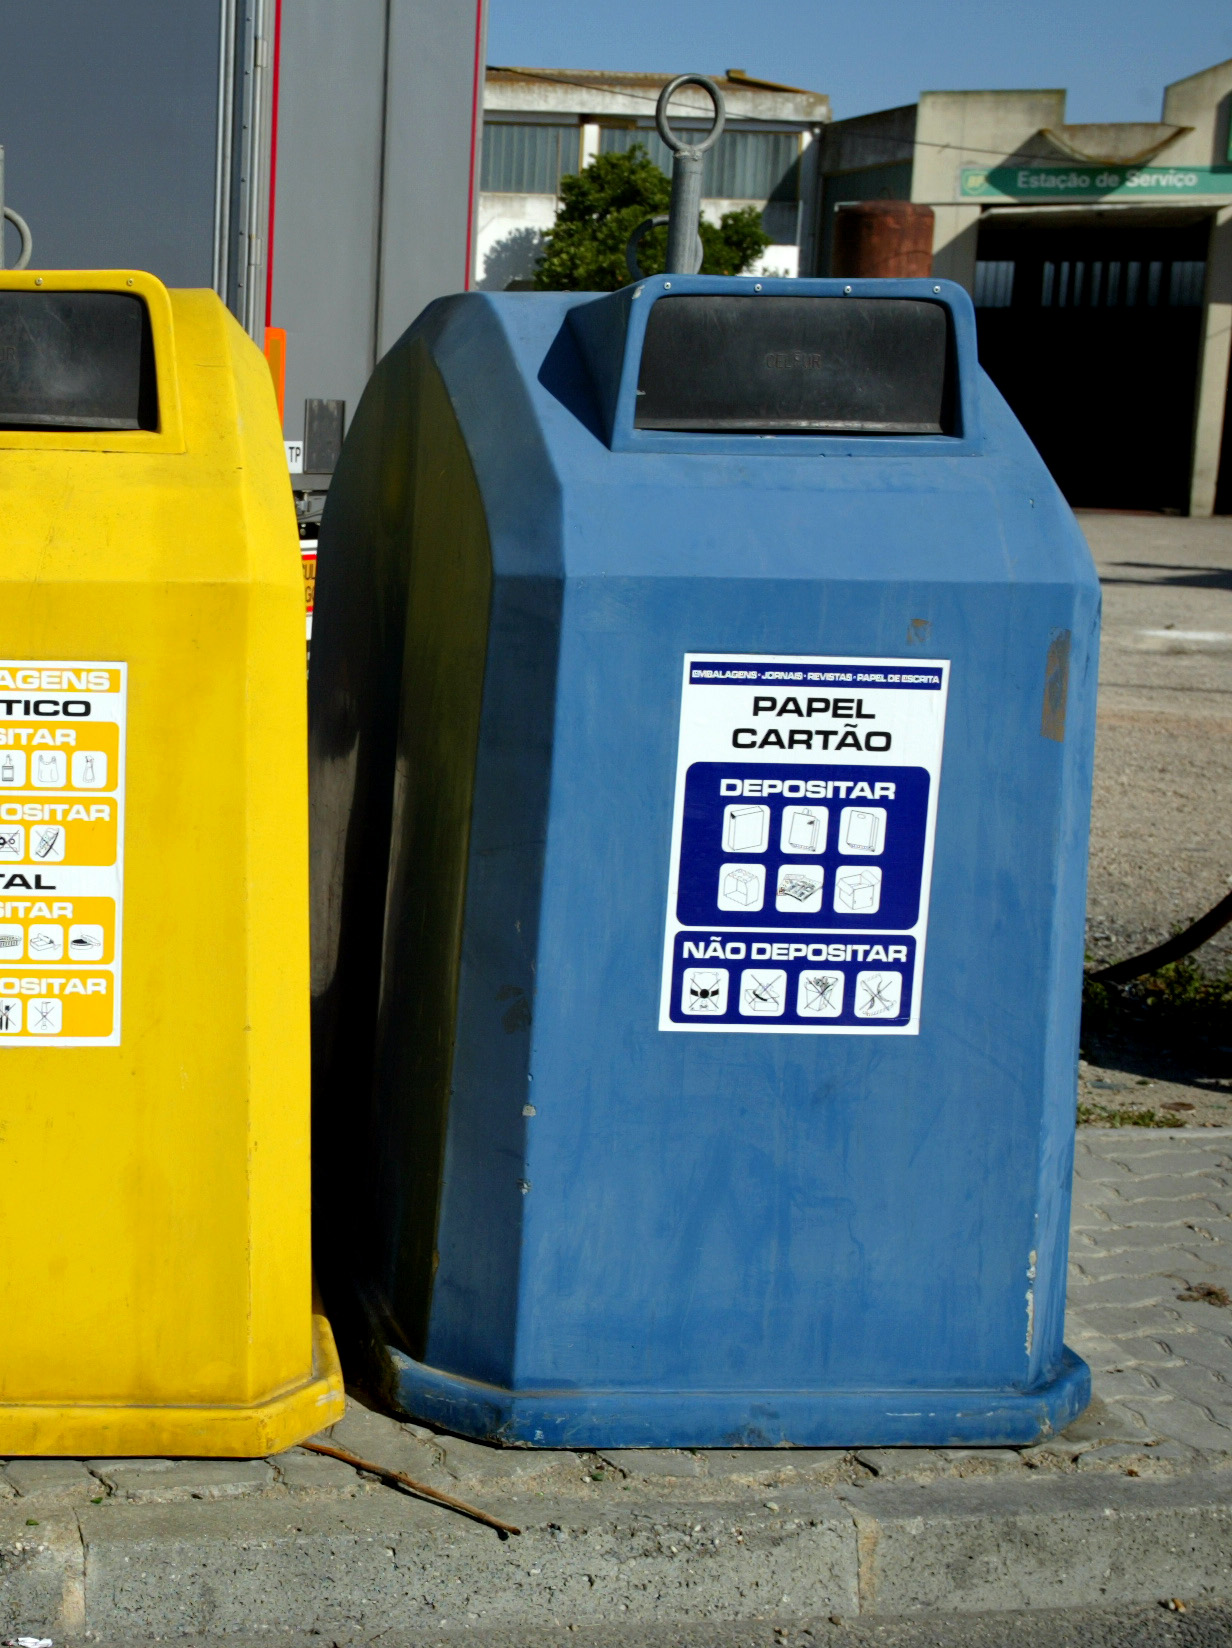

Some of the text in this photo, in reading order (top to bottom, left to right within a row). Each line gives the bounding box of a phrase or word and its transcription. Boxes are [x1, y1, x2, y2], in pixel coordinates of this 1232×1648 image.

[1018, 169, 1198, 189] Estação de Serviço
[692, 669, 939, 684] EMBALAGENS JORNAIS REVISTAS PAPEL DE ESCRITA
[753, 696, 876, 720] PAPEL
[732, 723, 892, 752] CARTÃO
[719, 778, 896, 800] DEPOSITAR
[682, 936, 907, 963] NÃO DEPOSITAR
